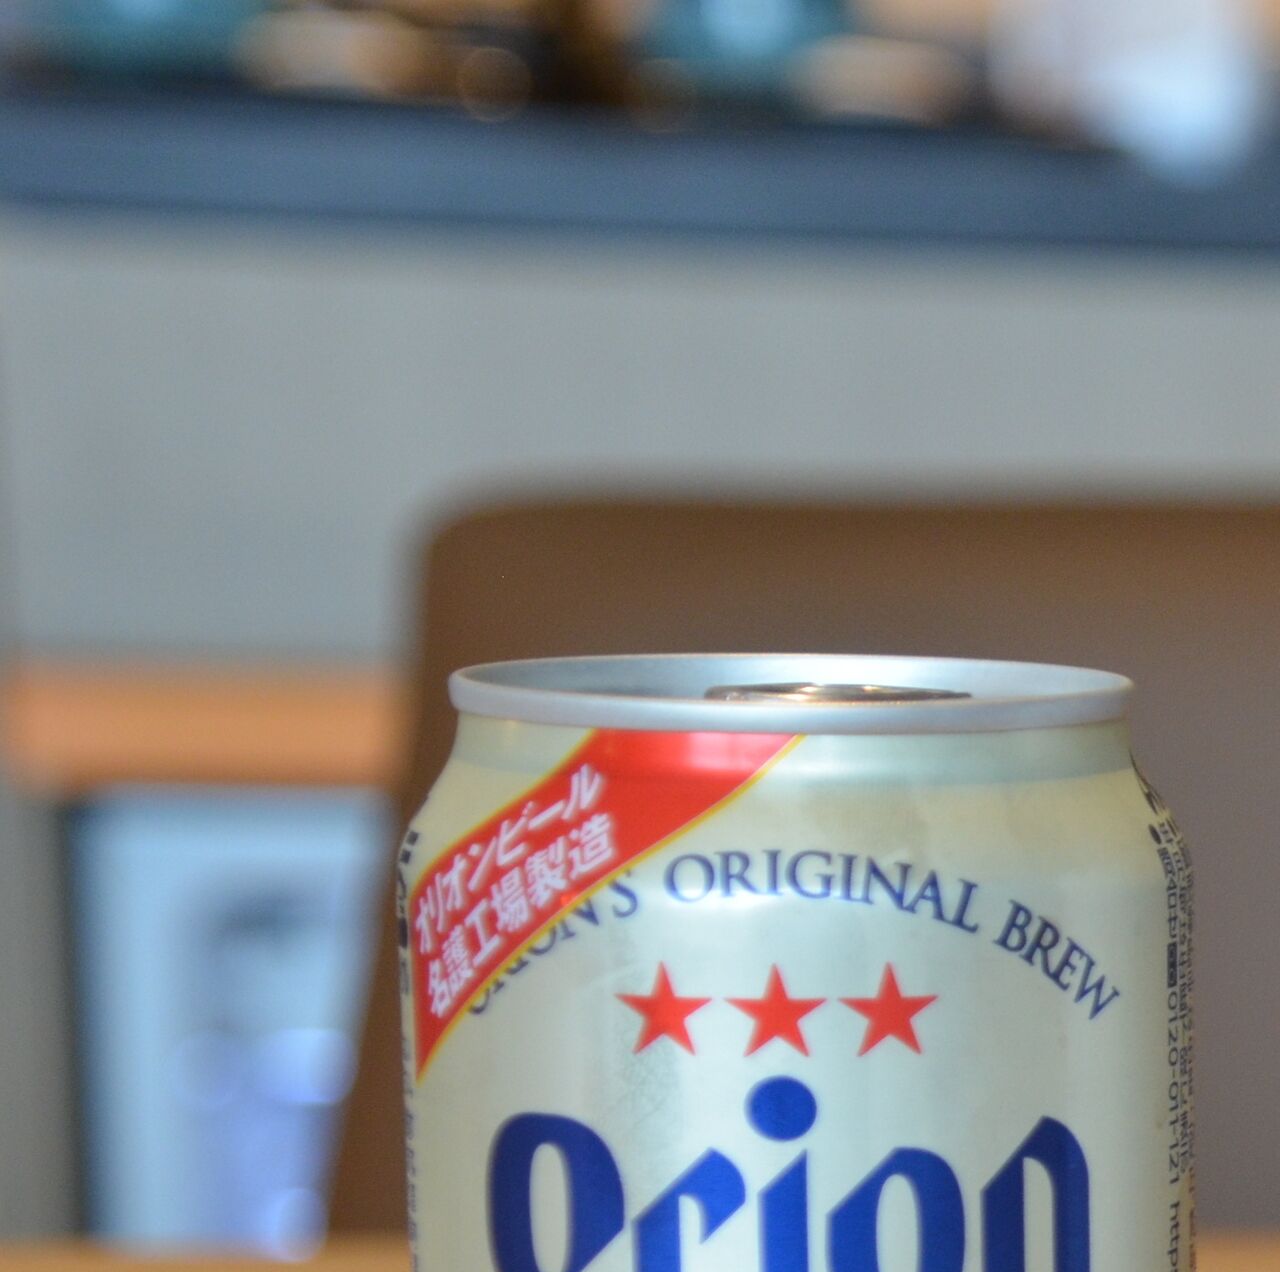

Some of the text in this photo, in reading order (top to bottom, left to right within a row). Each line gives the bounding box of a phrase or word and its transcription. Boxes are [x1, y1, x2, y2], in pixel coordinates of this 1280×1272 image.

[415, 763, 604, 954] オリオンビール
[428, 813, 615, 1019] 名護工場製造
[663, 849, 982, 934] ORIGINAL
[993, 898, 1120, 1022] BREW
